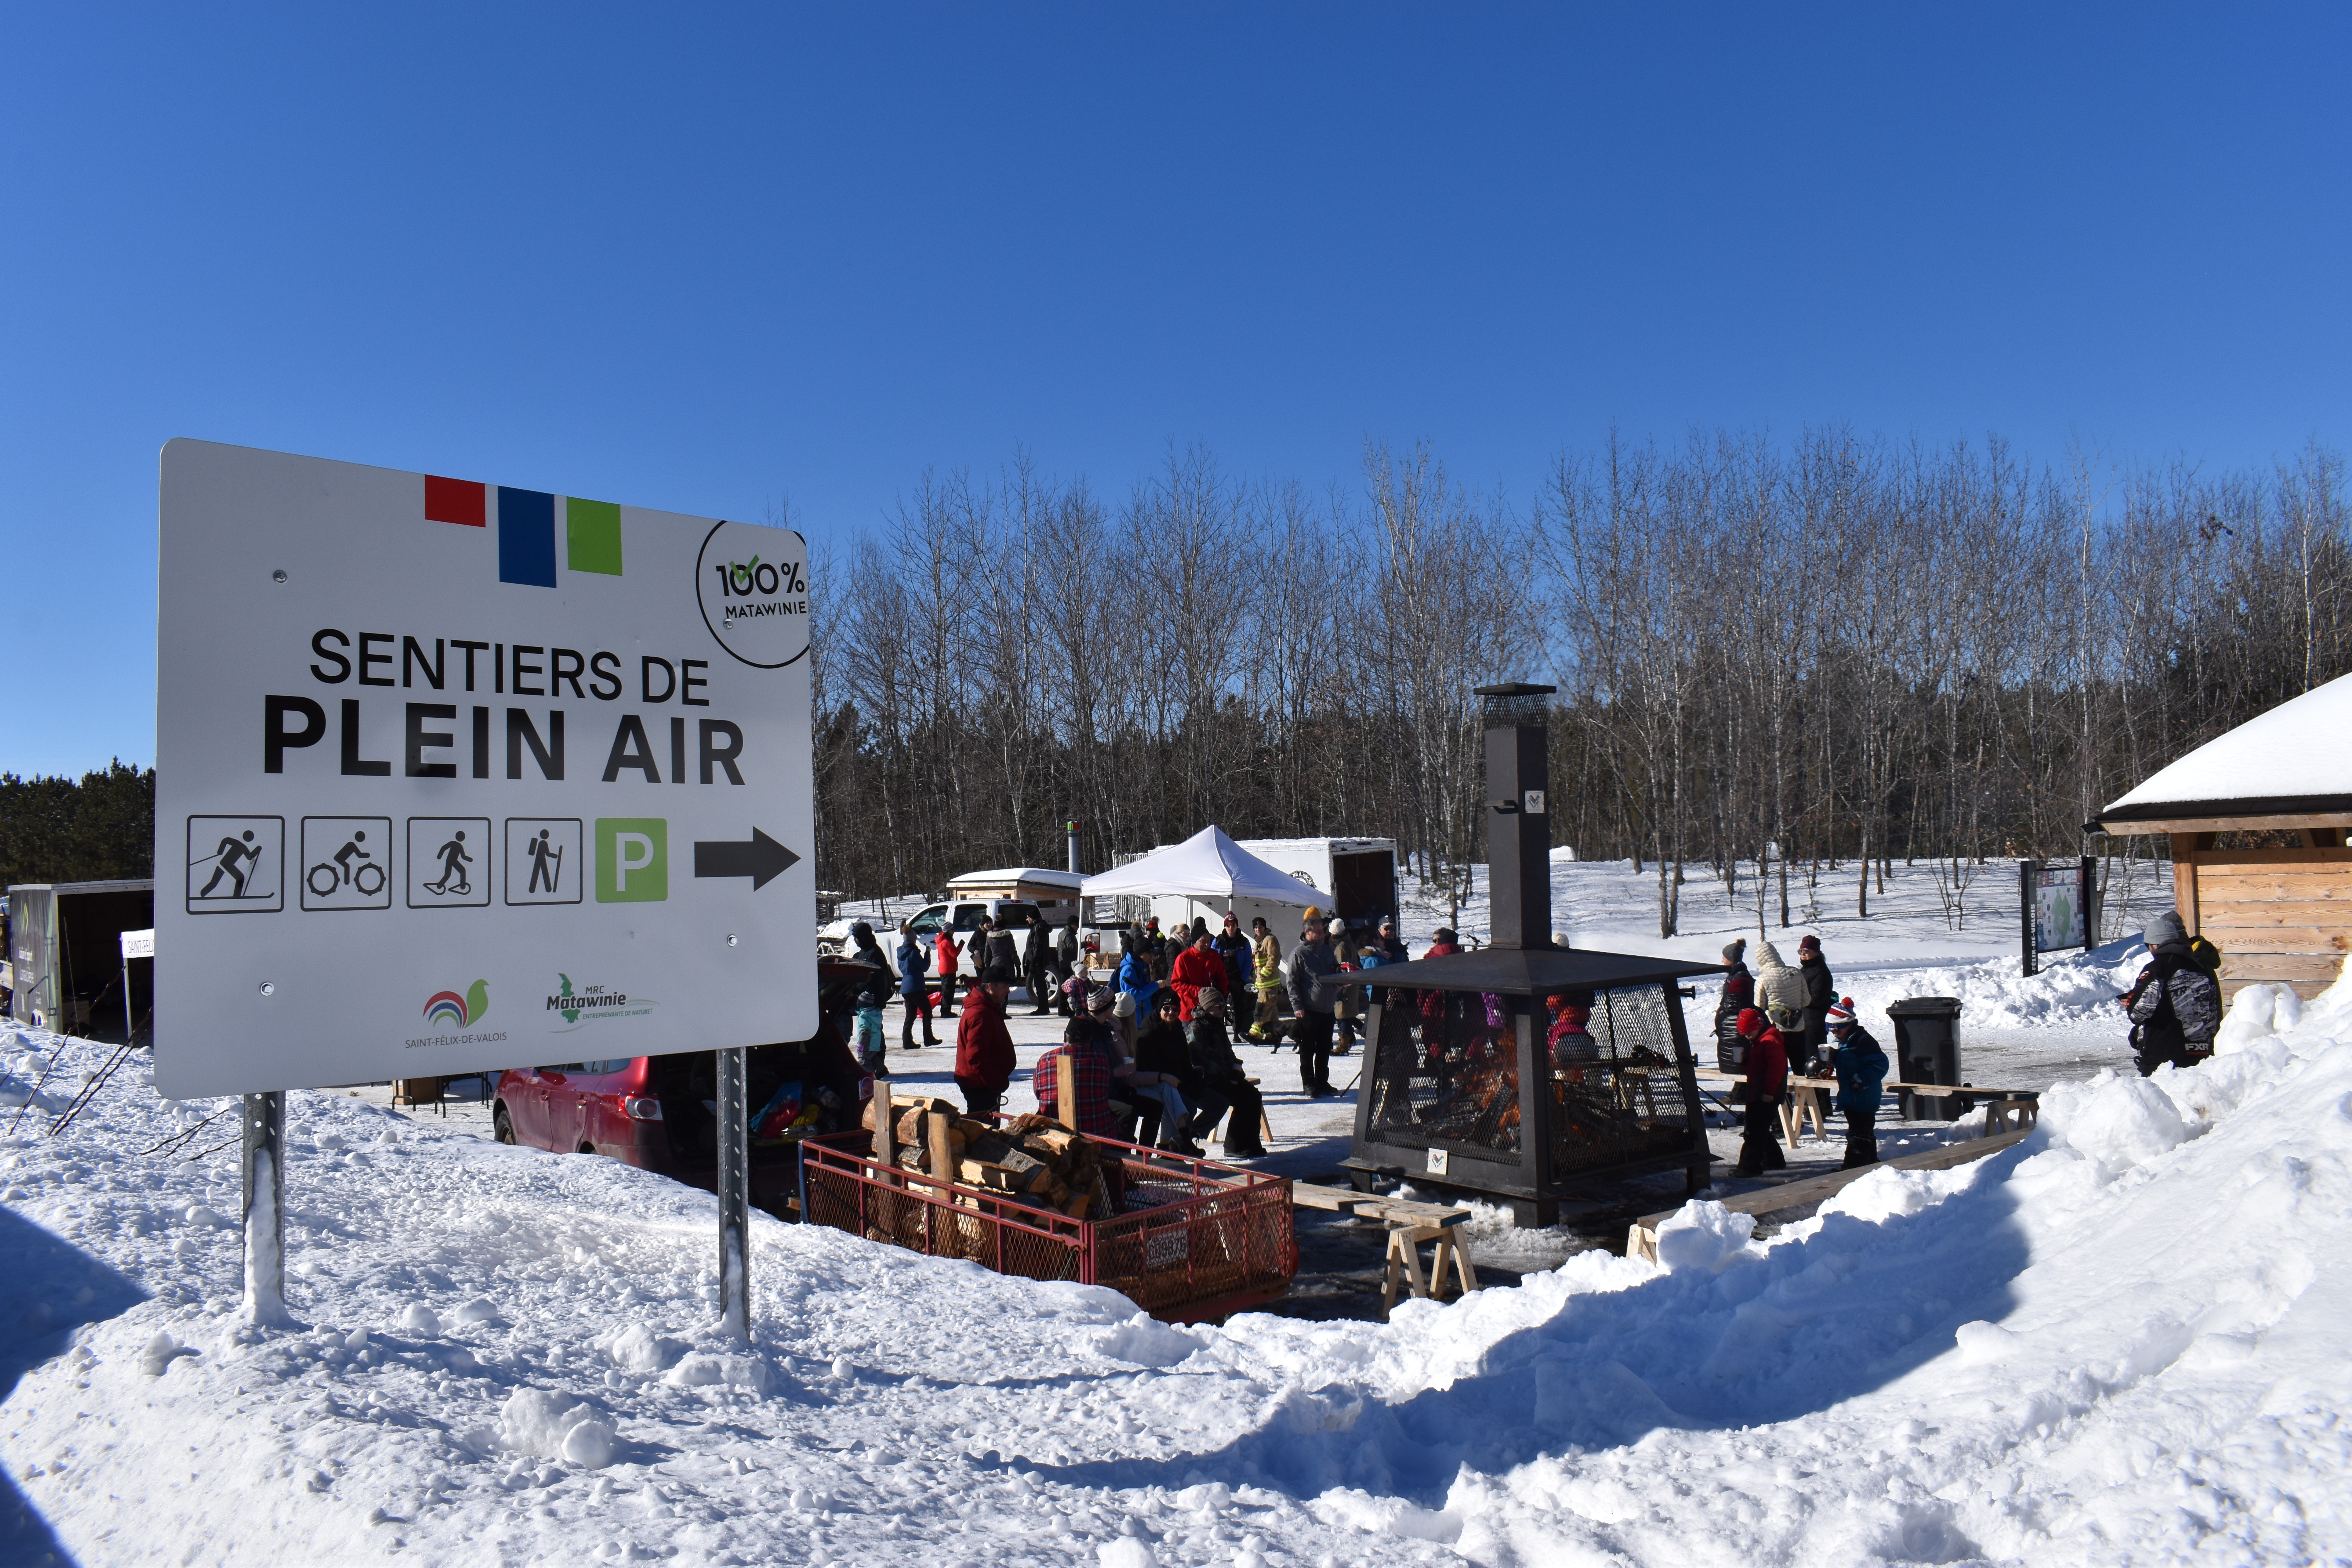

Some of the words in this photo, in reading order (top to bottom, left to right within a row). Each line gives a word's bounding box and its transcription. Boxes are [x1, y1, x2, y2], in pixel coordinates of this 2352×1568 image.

[716, 562, 805, 597] 100%
[725, 601, 807, 618] MATAWINIE
[310, 628, 622, 701] SENTIERS
[642, 655, 710, 706] DE
[264, 694, 564, 781] PLEIN
[601, 714, 745, 785] AIR
[616, 832, 654, 891] P
[586, 985, 605, 995] MRC
[546, 992, 626, 1011] Matawinie
[583, 1011, 624, 1019] ENTREPRENANTE
[632, 1007, 653, 1016] NATURE!
[405, 1032, 507, 1048] SAINT-FÉLIX-DE-VALOIS
